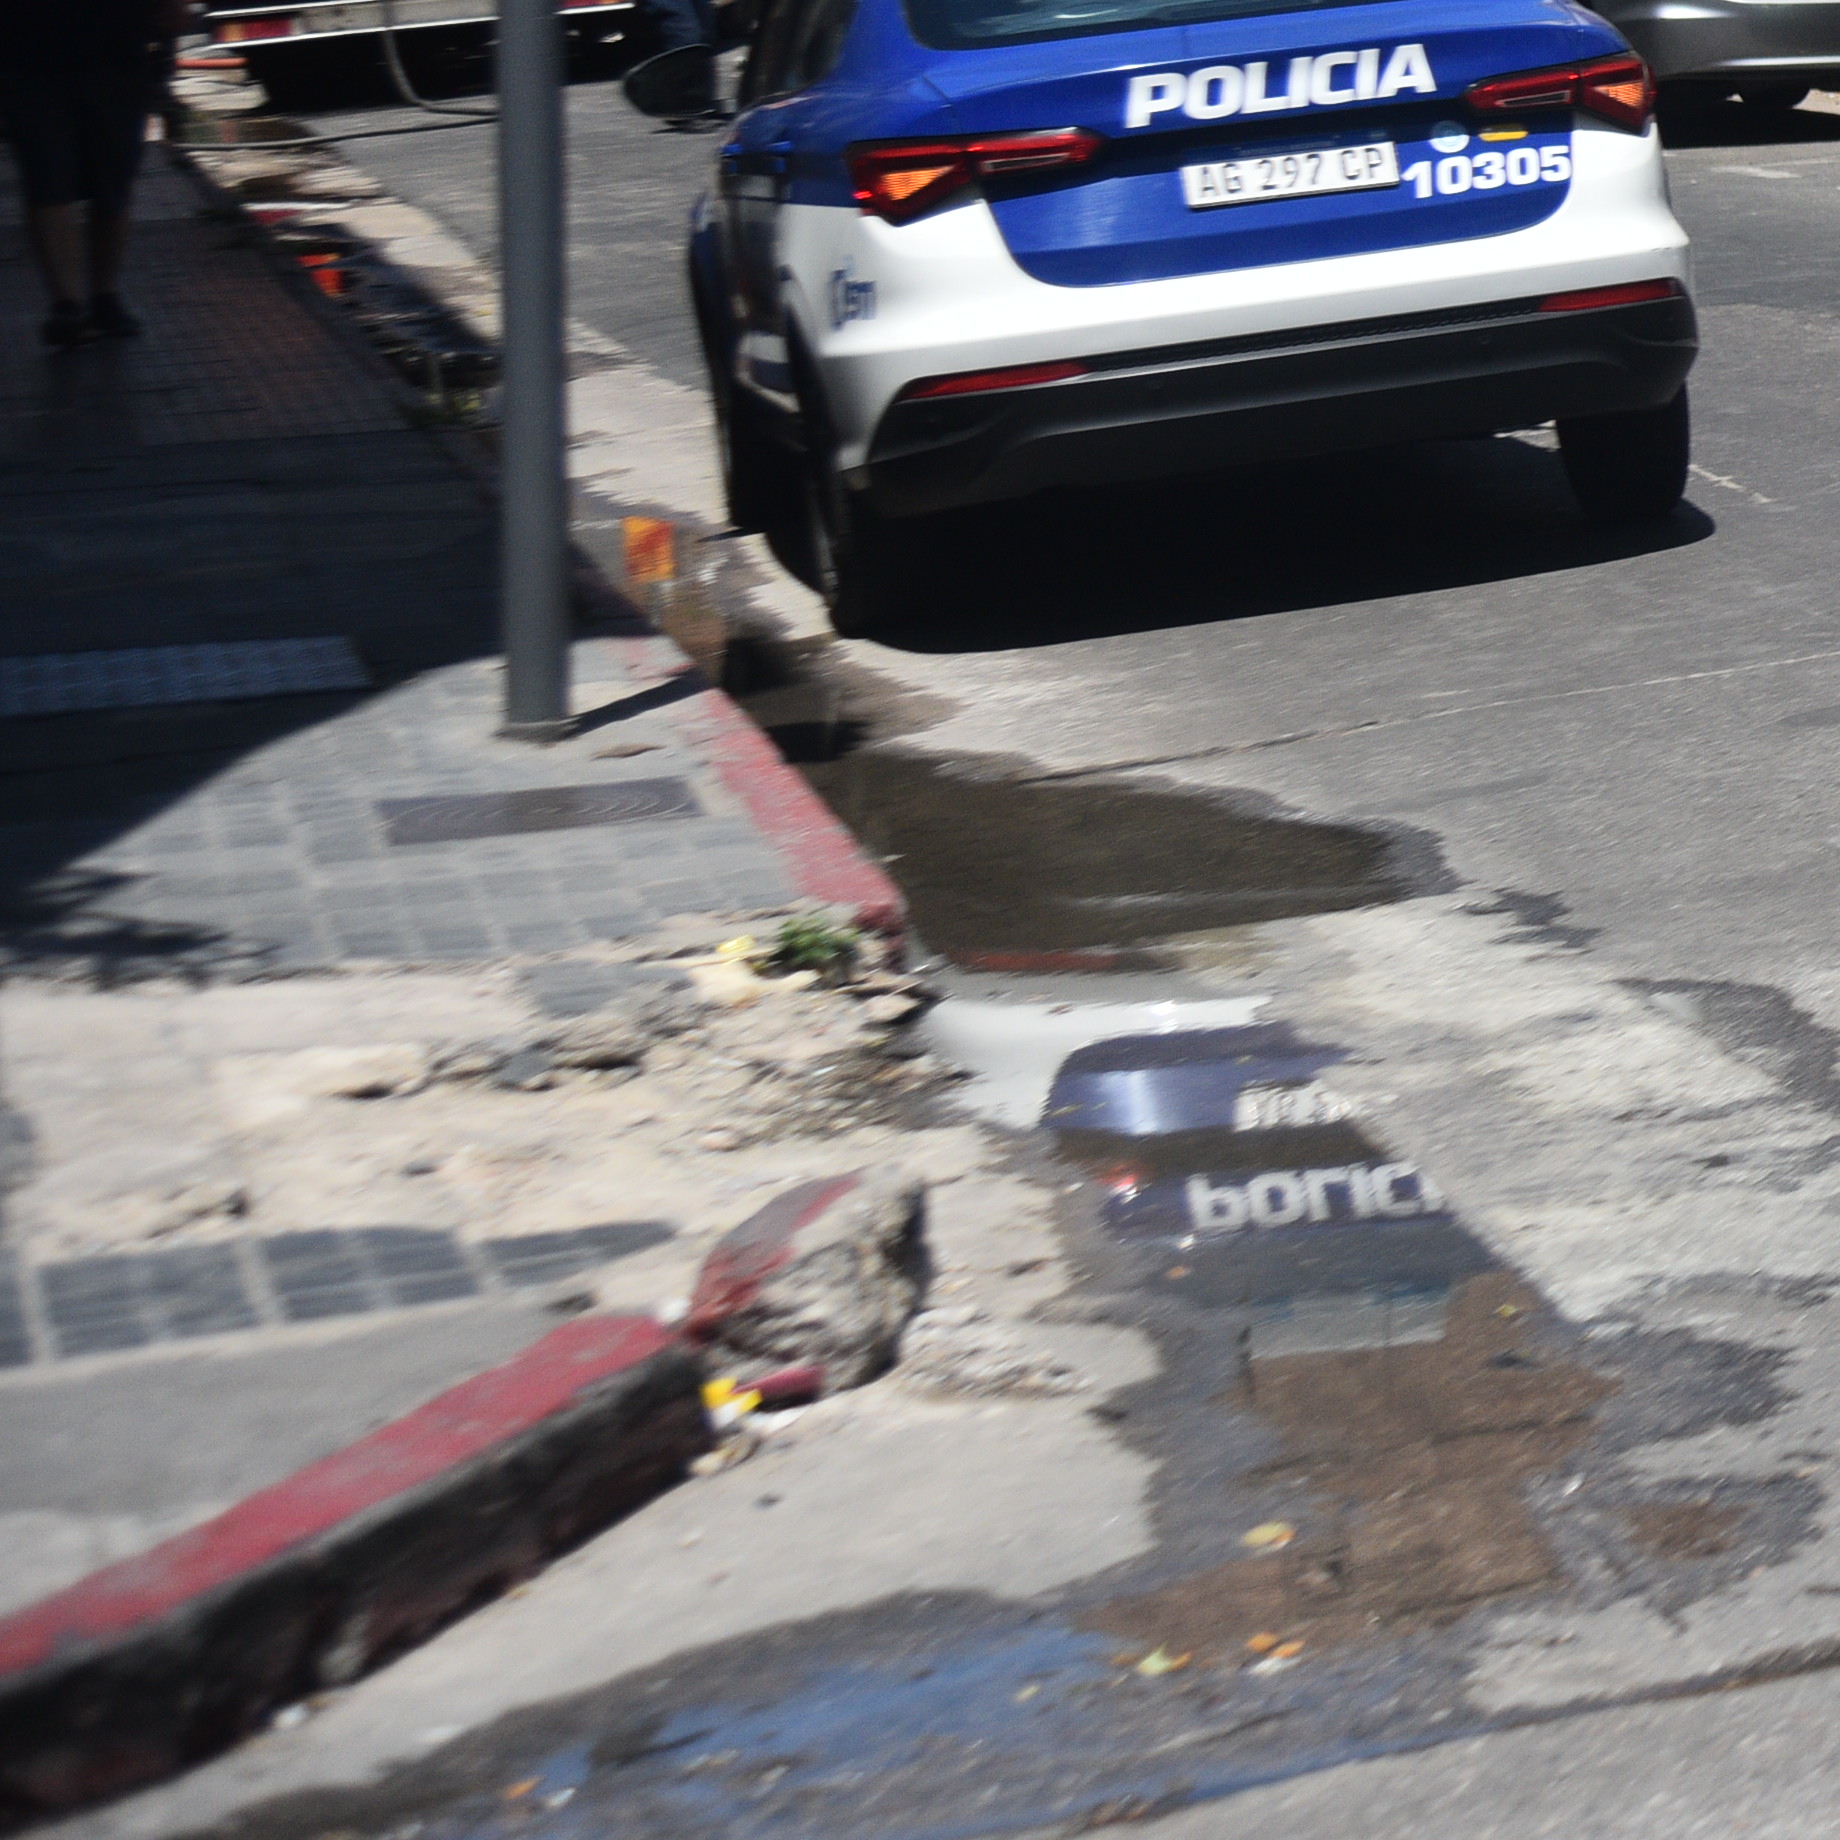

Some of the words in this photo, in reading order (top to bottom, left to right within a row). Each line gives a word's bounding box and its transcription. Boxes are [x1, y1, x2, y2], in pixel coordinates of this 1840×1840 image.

[1124, 43, 1438, 128] POLICIA
[1200, 162, 1242, 198] AG
[1259, 152, 1323, 191] 297
[1401, 145, 1573, 200] 10305
